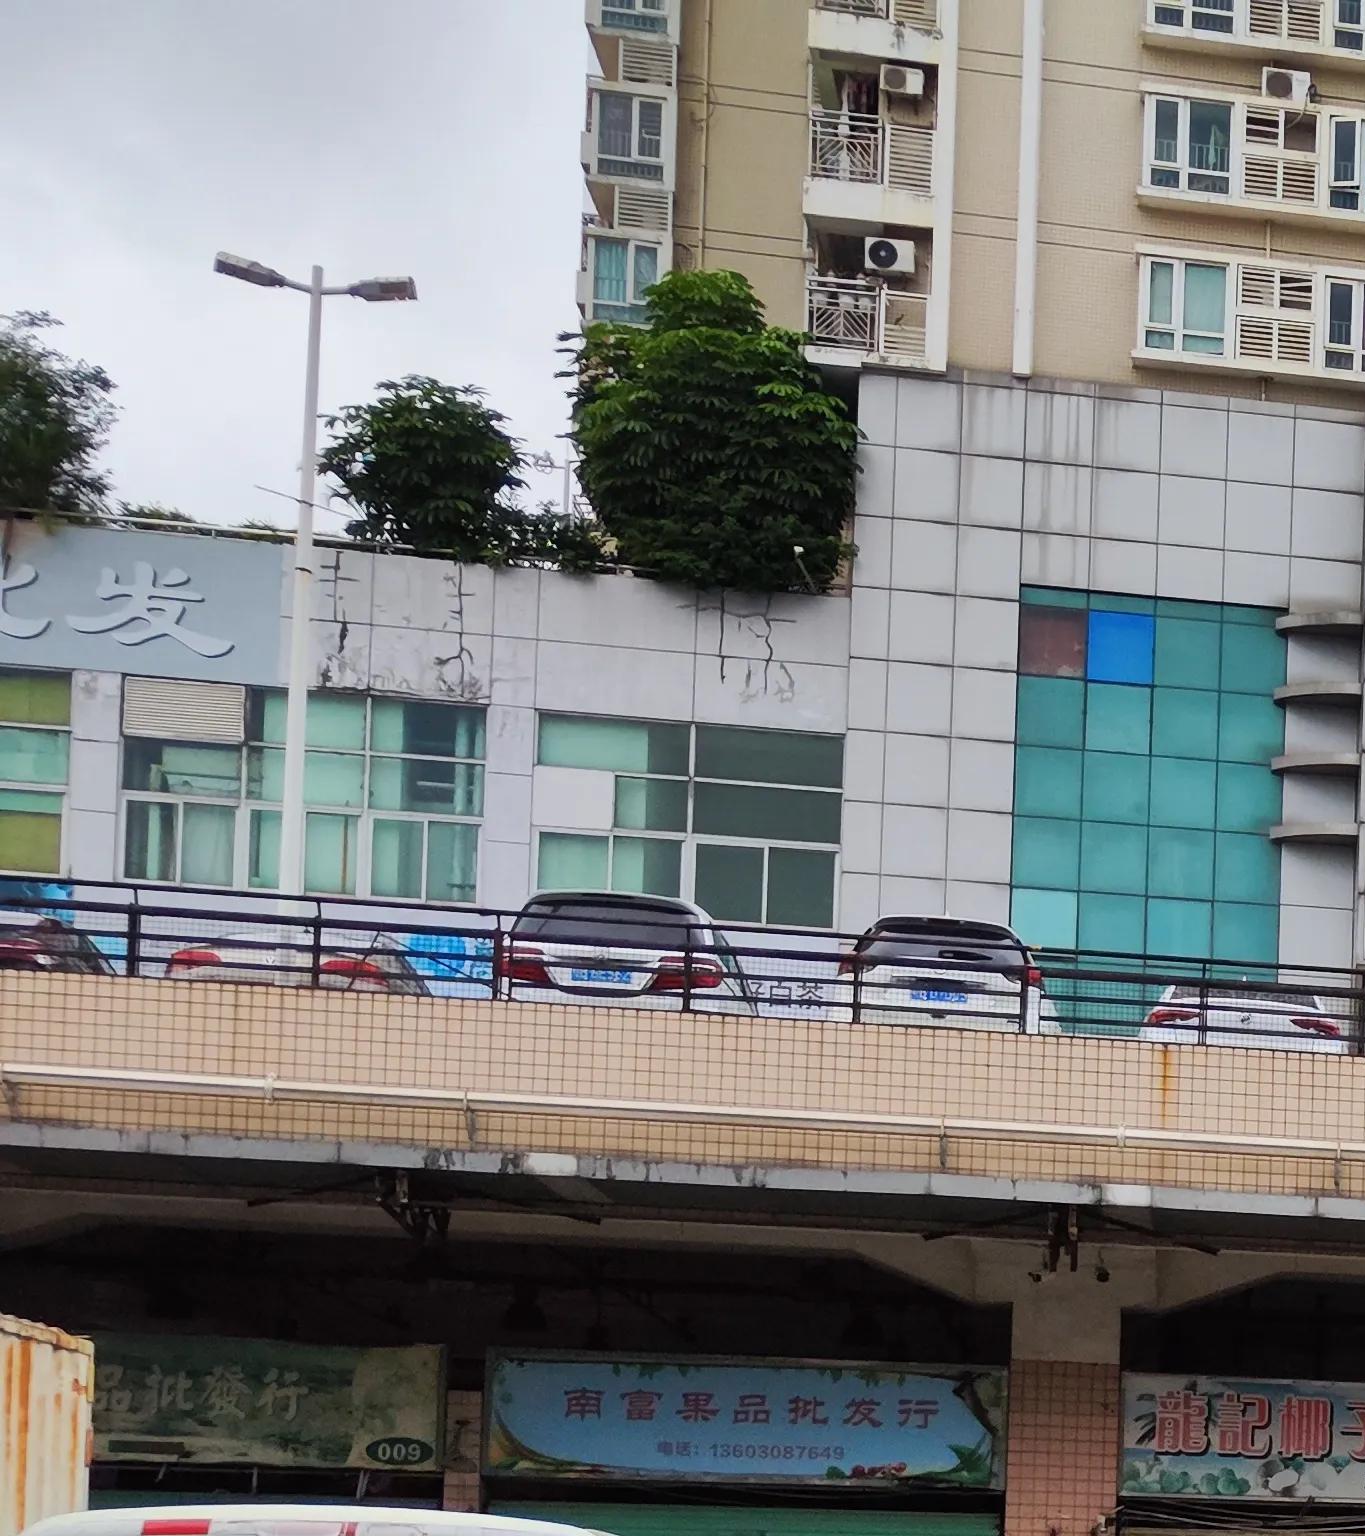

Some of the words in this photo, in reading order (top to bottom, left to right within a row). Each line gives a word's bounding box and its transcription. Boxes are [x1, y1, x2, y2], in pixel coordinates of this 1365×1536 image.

[564, 1386, 940, 1431] 南富果品批发行
[377, 1443, 421, 1462] 009
